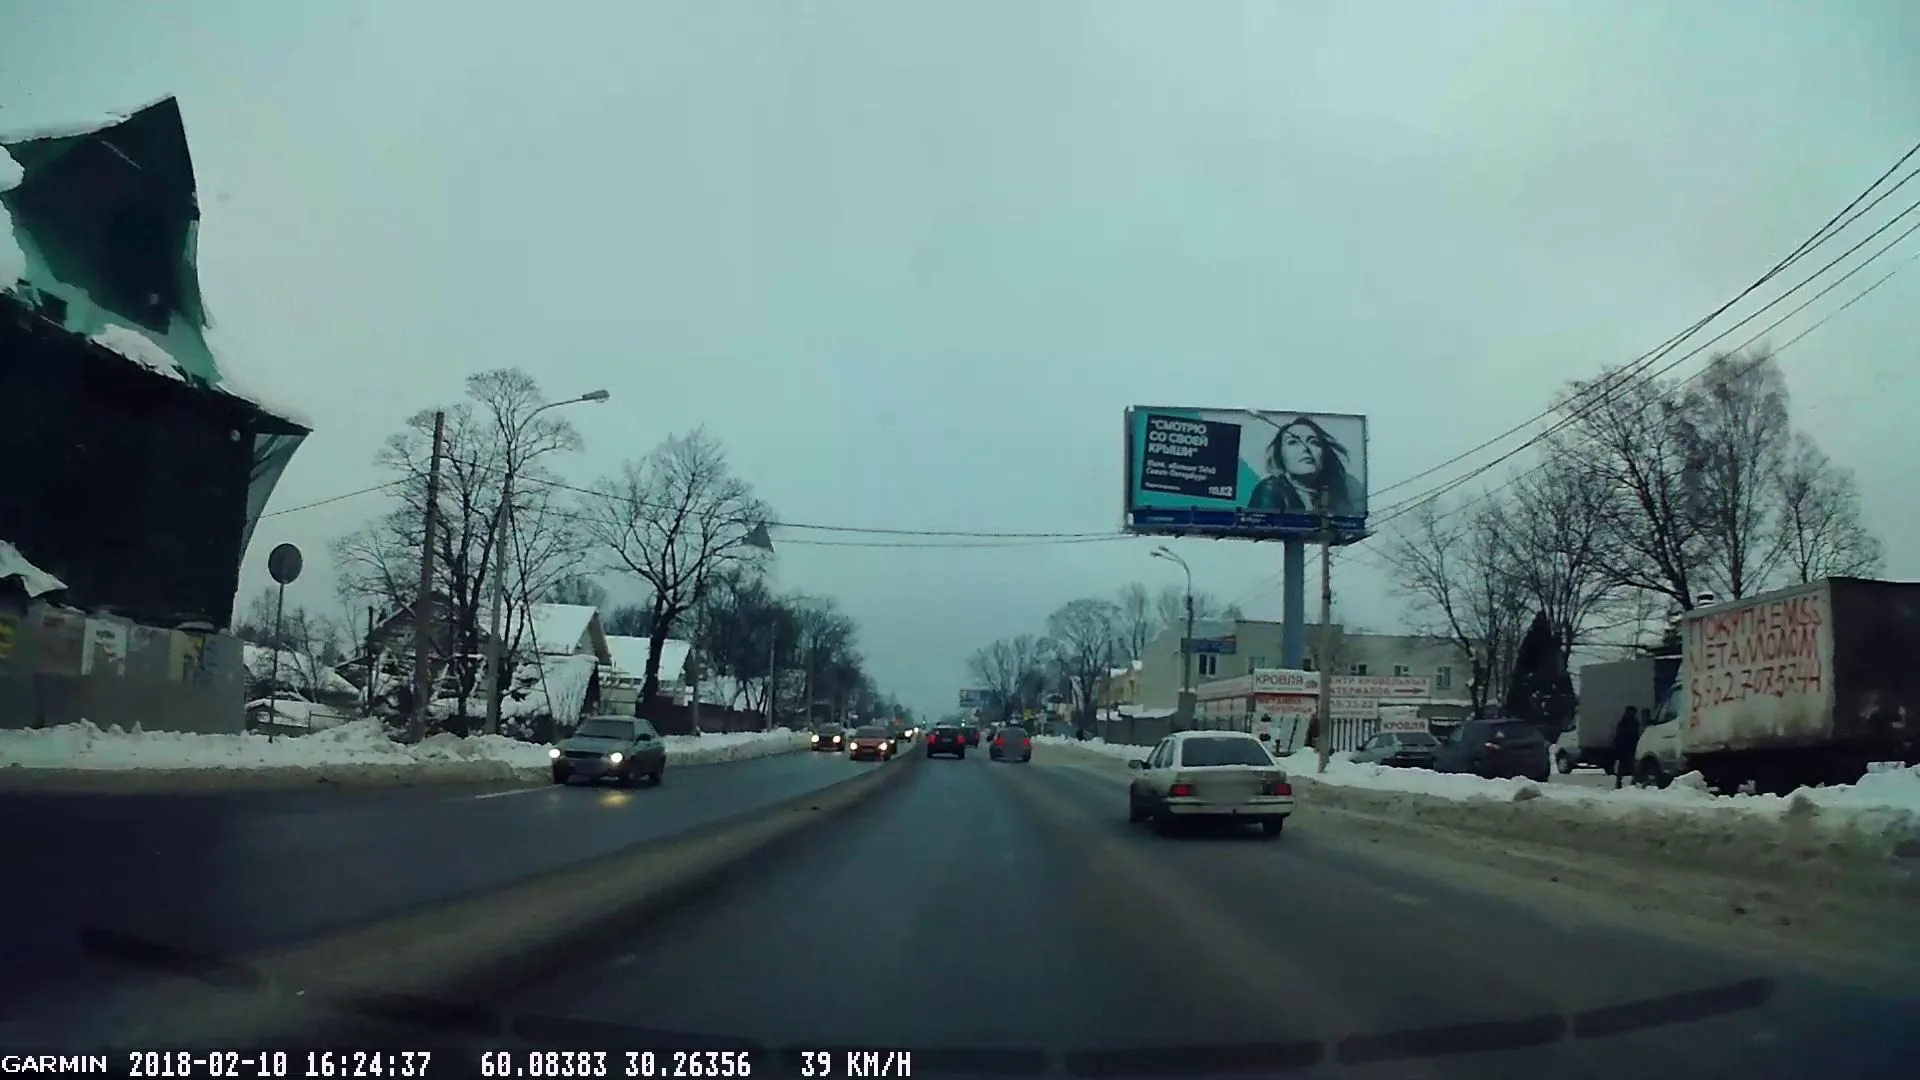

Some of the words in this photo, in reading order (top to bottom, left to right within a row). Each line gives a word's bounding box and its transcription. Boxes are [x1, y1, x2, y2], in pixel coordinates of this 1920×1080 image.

[1148, 430, 1167, 442] СО
[1168, 432, 1209, 447] СВОЕЙ
[1255, 673, 1303, 685] КРОВЛЯ
[1329, 677, 1358, 686] ЕНТР
[1329, 686, 1390, 695] АТЕРИАЛОВ
[1383, 721, 1425, 730] КРОВЛЯ
